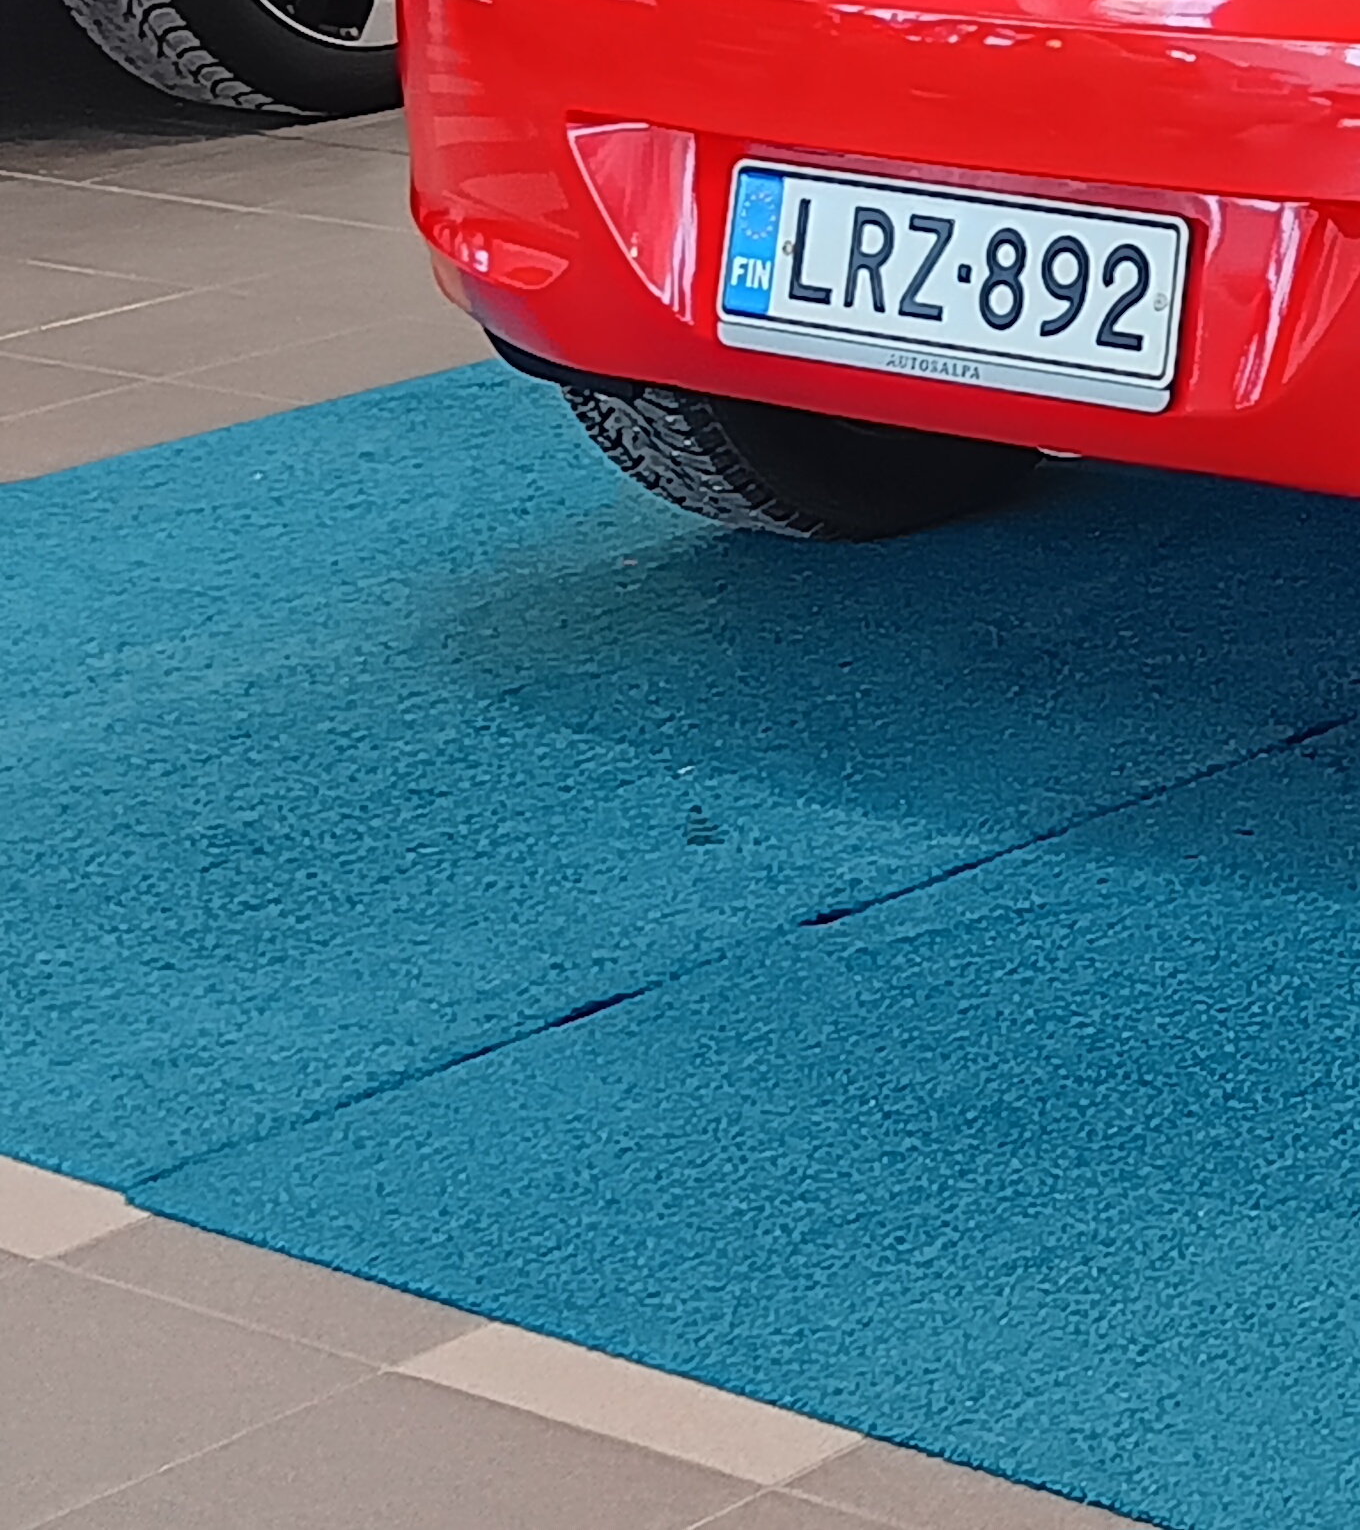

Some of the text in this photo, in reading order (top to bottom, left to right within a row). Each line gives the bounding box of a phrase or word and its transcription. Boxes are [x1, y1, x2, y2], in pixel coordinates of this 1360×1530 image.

[730, 255, 771, 291] FIN
[788, 198, 1150, 352] LRZ-892
[885, 353, 981, 381] AUTOSALPA
